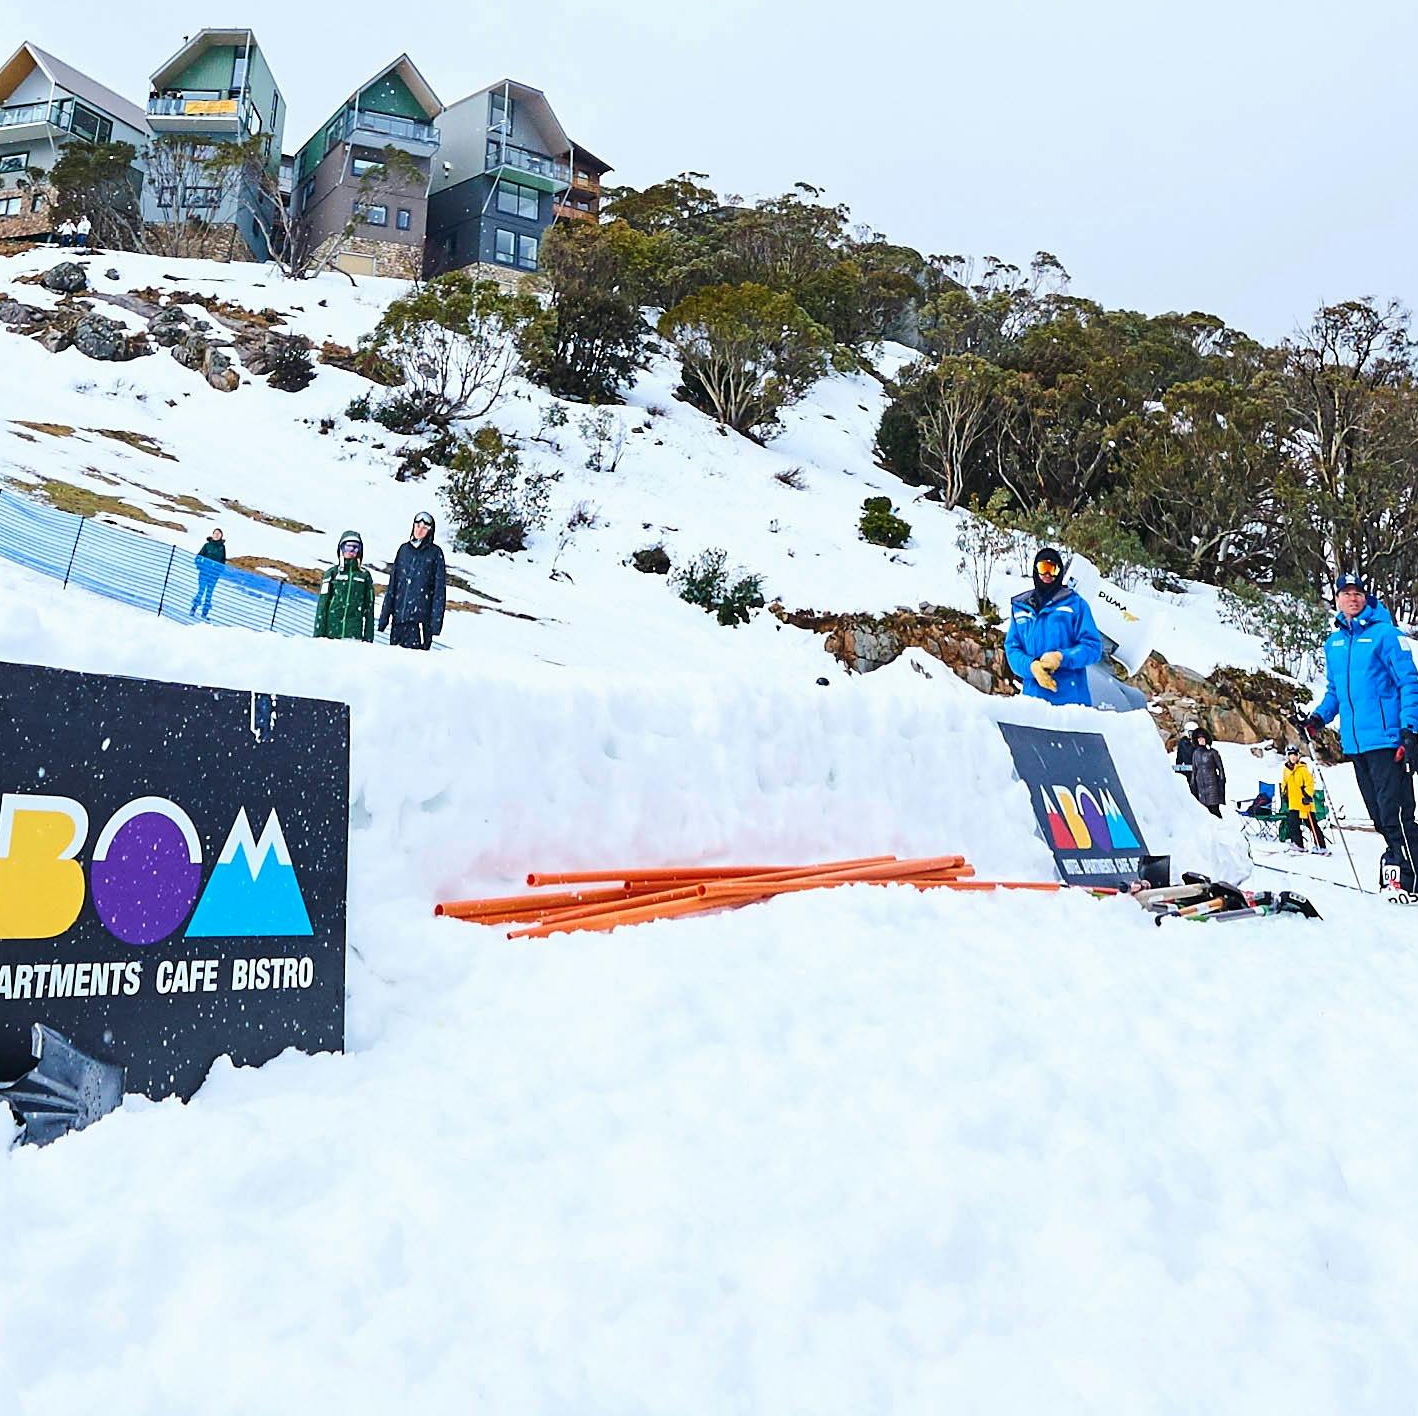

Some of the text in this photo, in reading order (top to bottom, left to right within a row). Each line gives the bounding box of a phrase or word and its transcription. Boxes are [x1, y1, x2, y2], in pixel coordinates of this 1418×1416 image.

[1039, 784, 1142, 854] ABOM
[155, 959, 220, 995] CAFE
[231, 957, 314, 992] BISTRO
